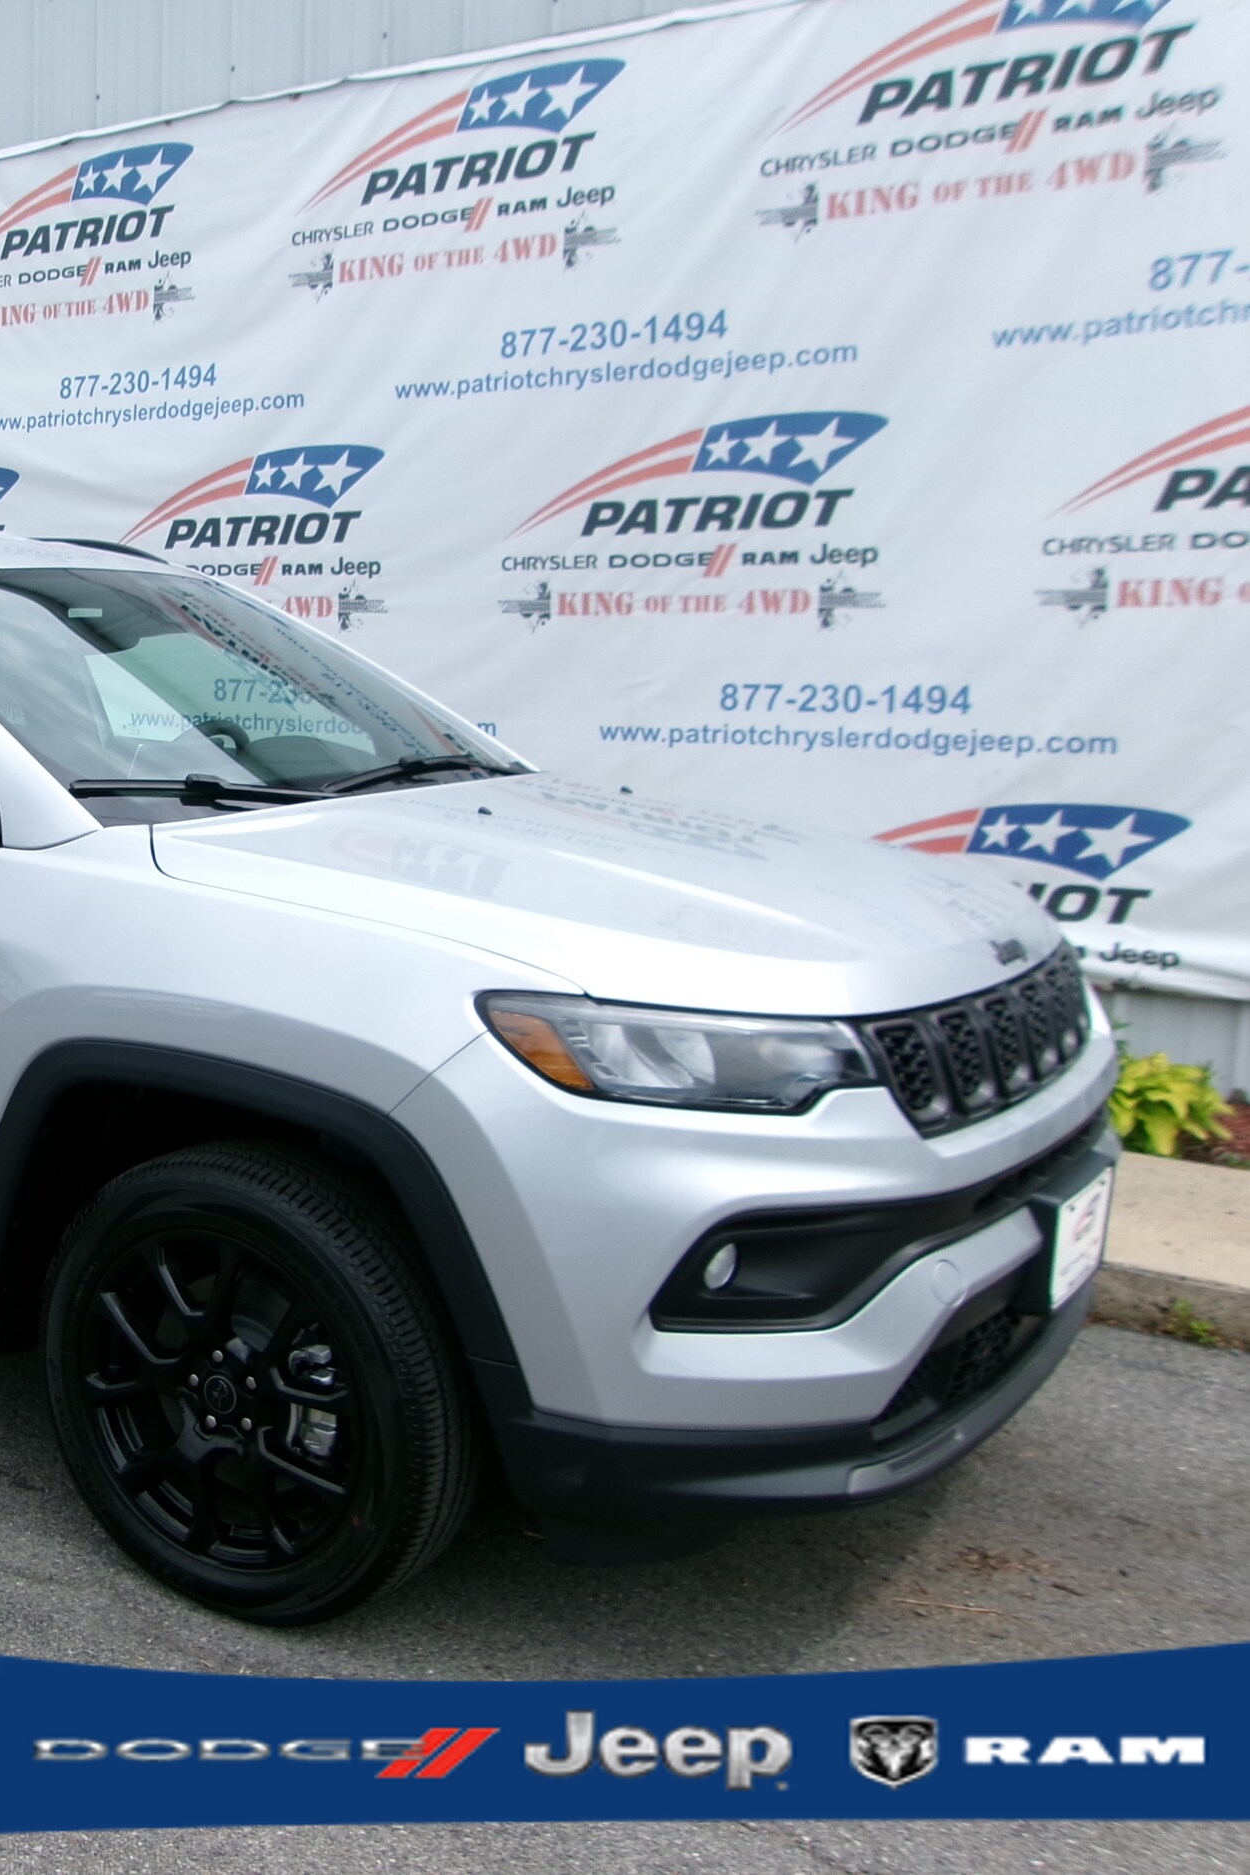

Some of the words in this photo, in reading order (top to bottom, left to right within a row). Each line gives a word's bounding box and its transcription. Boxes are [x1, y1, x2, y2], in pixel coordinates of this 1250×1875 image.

[856, 20, 1198, 126] PATRIOT
[760, 143, 878, 178] CHRYSLER
[1052, 106, 1123, 133] RAM
[1135, 83, 1224, 121] Jeep
[361, 131, 597, 207] PATRIOT
[826, 182, 920, 220] KING
[933, 178, 967, 204] OF
[975, 170, 1034, 198] THE
[1045, 150, 1137, 192] 4WD
[0, 204, 175, 261] PATRIOT
[291, 220, 374, 247] CHRYSLER
[497, 197, 548, 217] RAM
[556, 185, 616, 209] Jeep
[104, 258, 142, 274] RAM
[148, 249, 192, 270] Jeep
[338, 250, 404, 284] KING
[413, 250, 438, 271] OF
[444, 246, 485, 268] THE
[493, 232, 558, 264] 4WD
[42, 301, 62, 320] OF
[65, 299, 96, 317] THE
[102, 289, 149, 316] 4WD
[500, 309, 729, 359] 877-230-1494
[59, 362, 217, 400] 877-230-1494
[395, 341, 858, 400] www.patriotchryslerdodgejeep.com
[164, 510, 362, 550] PATRIOT
[580, 488, 856, 537] PATRIOT
[501, 555, 598, 572] CHRYSLER
[741, 549, 800, 566] RAM
[810, 542, 879, 567] Jeep
[1042, 533, 1175, 556] CHRYSLER
[282, 563, 323, 576] RAM
[330, 556, 381, 579] Jeep
[557, 592, 635, 617] KING
[645, 595, 671, 613] OF
[678, 594, 727, 612] THE
[737, 588, 812, 615] 4WD
[1117, 577, 1223, 608] KING
[720, 683, 972, 715] 877-230-1494
[599, 722, 1118, 758] www.patriotchryslerdodgejeep.com
[1099, 942, 1179, 969] Jeep
